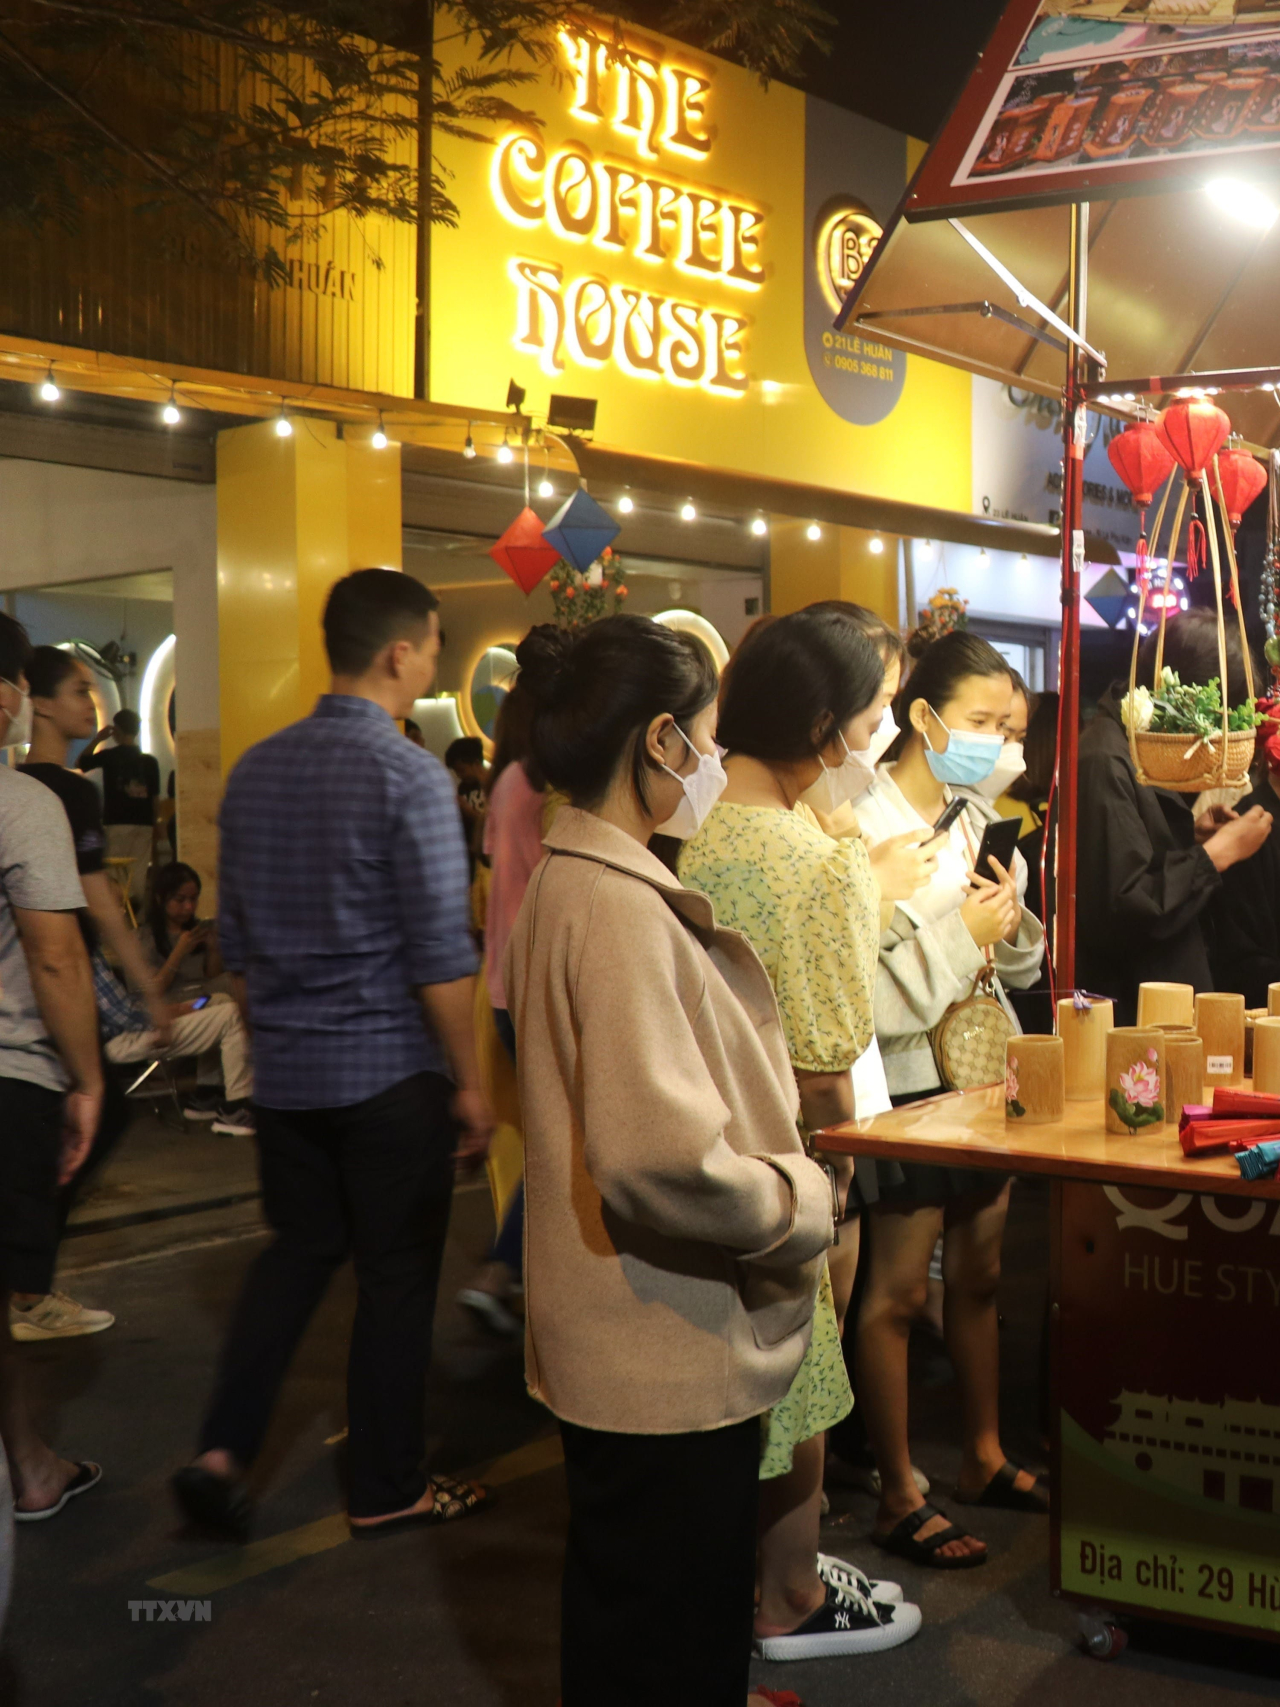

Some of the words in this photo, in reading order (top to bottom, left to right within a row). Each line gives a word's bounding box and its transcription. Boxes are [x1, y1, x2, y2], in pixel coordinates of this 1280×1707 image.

[559, 29, 713, 156] THE
[498, 134, 767, 285] COFFEE
[513, 260, 750, 391] HOUSE
[864, 343, 892, 361] HUÂN
[836, 356, 859, 373] 0905
[861, 361, 878, 378] 368
[880, 366, 893, 381] 811
[1124, 1252, 1203, 1298] HUE
[1079, 1540, 1123, 1584] Địa
[1135, 1555, 1185, 1593] chỉ:
[1197, 1564, 1234, 1602] 29
